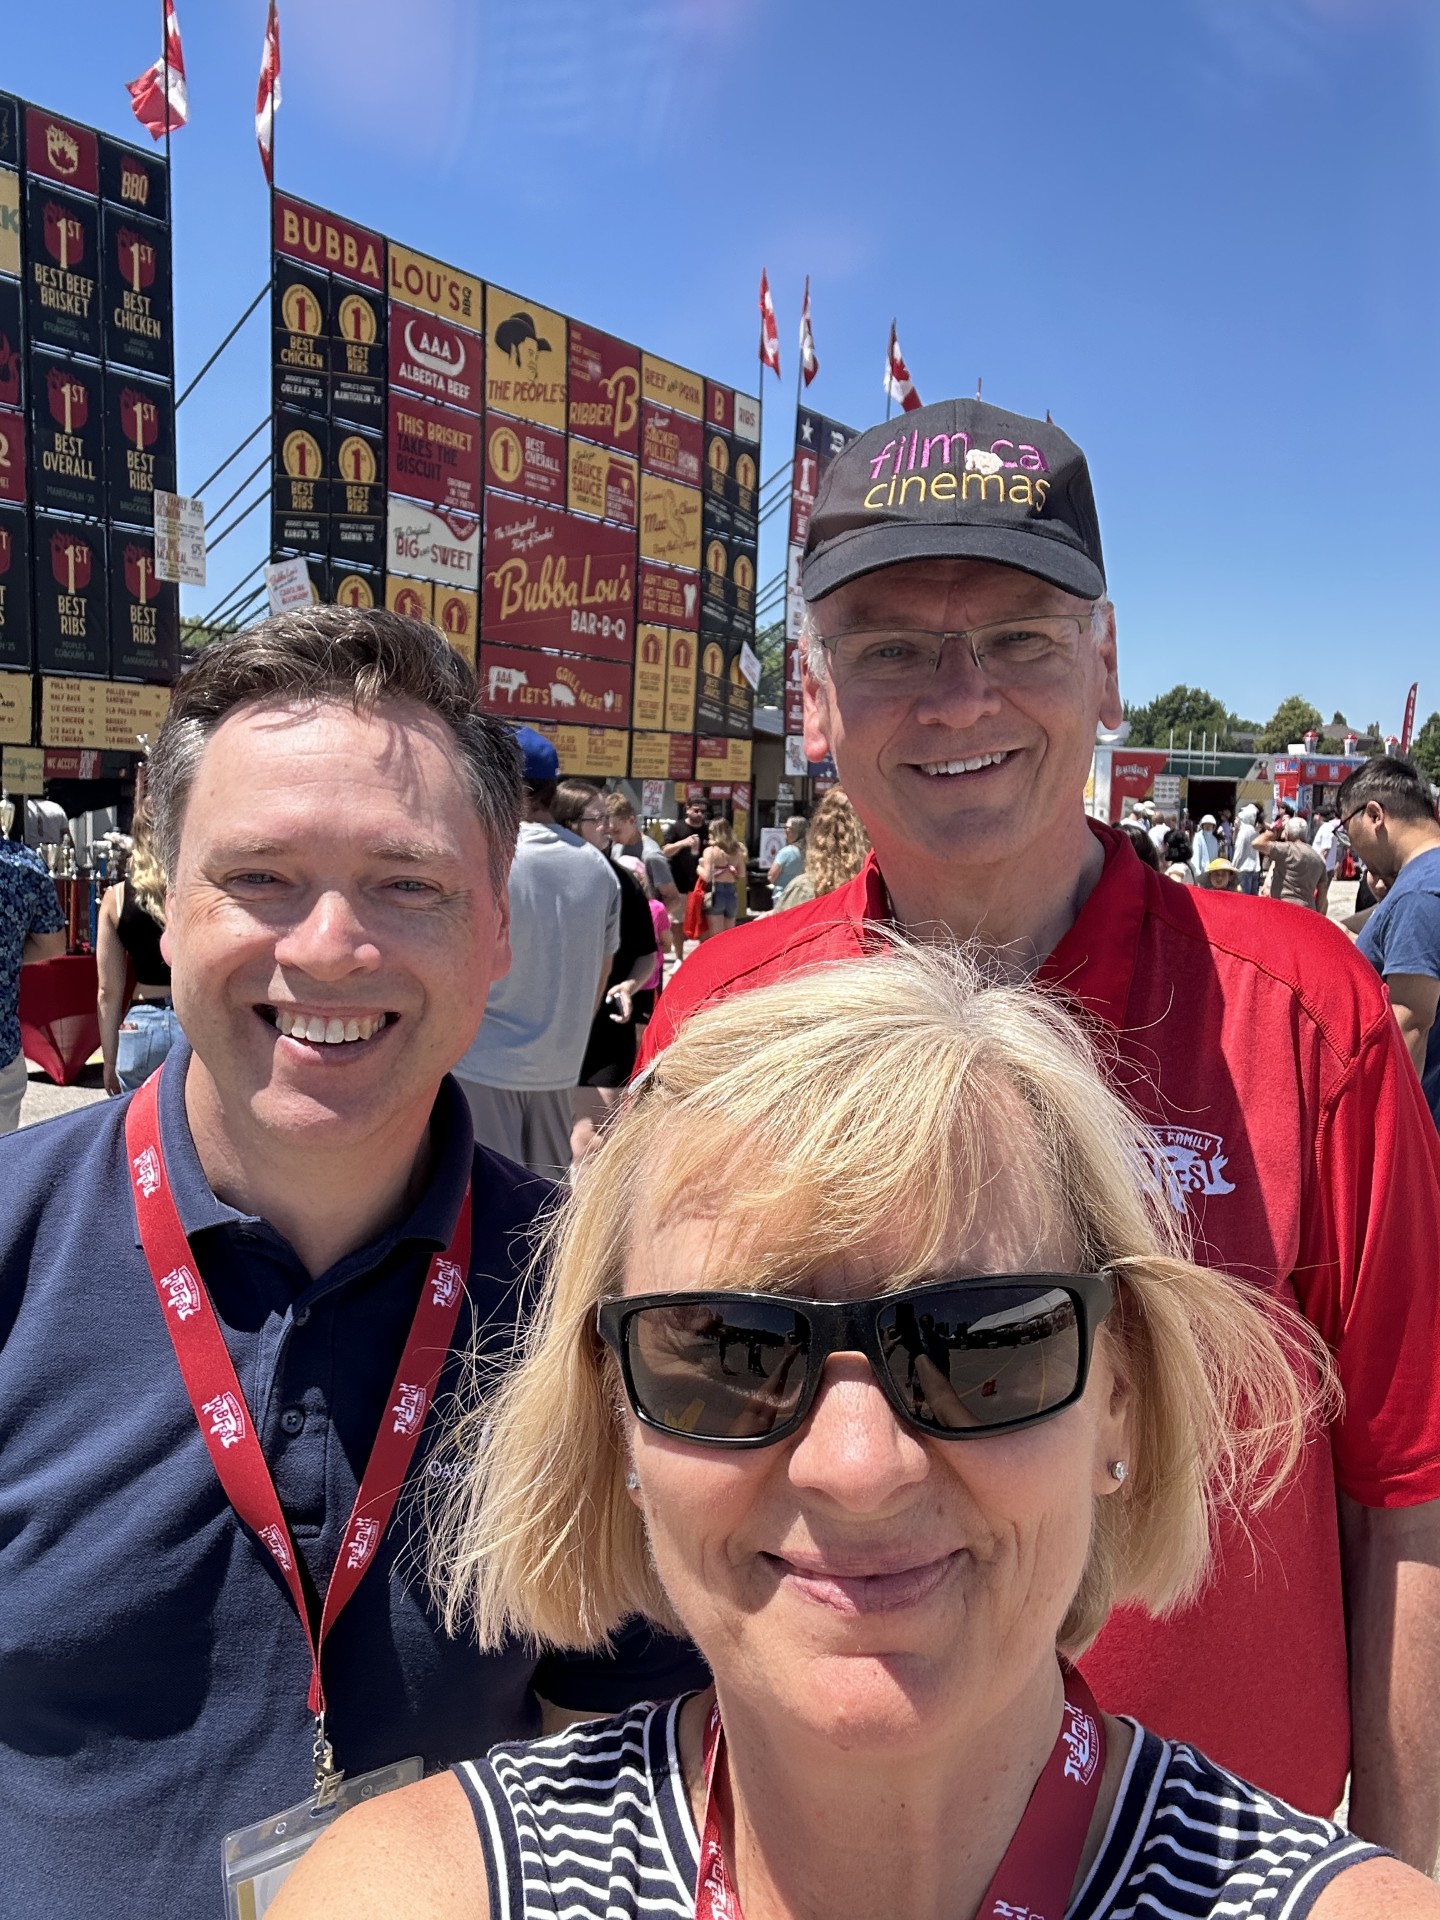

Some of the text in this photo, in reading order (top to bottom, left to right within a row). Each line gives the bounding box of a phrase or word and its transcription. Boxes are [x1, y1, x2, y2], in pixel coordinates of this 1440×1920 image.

[121, 170, 148, 205] BBQ
[57, 217, 81, 269] 1ST
[283, 208, 380, 280] BUBBA
[35, 262, 94, 298] BEST BEEF
[129, 242, 153, 292] 1ST
[390, 255, 461, 312] LOU'S
[40, 284, 90, 318] BRISKET
[123, 290, 151, 317] BEST
[114, 307, 162, 340] CHICKEN
[289, 335, 315, 352] BEST
[346, 343, 370, 360] BEST
[419, 331, 453, 361] AAA
[281, 348, 324, 369] CHICKEN
[280, 383, 311, 396] ORLEANS
[398, 362, 471, 400] ALBERTA BEEF
[488, 379, 567, 402] THE PEOPLE'S
[60, 383, 85, 434] 1ST
[569, 401, 614, 426] RIBBER
[133, 401, 155, 451] 1ST
[396, 412, 474, 451] THIS BRISKET
[55, 432, 83, 458] BEST
[397, 433, 458, 467] TAKES THE
[524, 436, 546, 452] BEST
[43, 450, 96, 481] OVERALL
[127, 450, 155, 476] BEST
[396, 454, 442, 481] BISCUIT
[129, 470, 154, 493] RIBS
[290, 480, 315, 497] BEST
[346, 485, 370, 500] BEST
[864, 471, 1051, 511] cinemas
[291, 495, 314, 510] RIBS
[347, 499, 369, 513] RIBS
[395, 533, 420, 559] BIG
[430, 543, 474, 571] SWEET
[65, 545, 89, 594] 1ST
[136, 555, 153, 604] 1S
[485, 554, 632, 621] Bubba Lou's
[58, 595, 87, 618] BEST
[129, 604, 157, 626] BEST
[60, 614, 86, 638] RIBS
[132, 623, 157, 646] RIBS
[496, 670, 513, 683] AAA
[519, 686, 550, 704] LET'S
